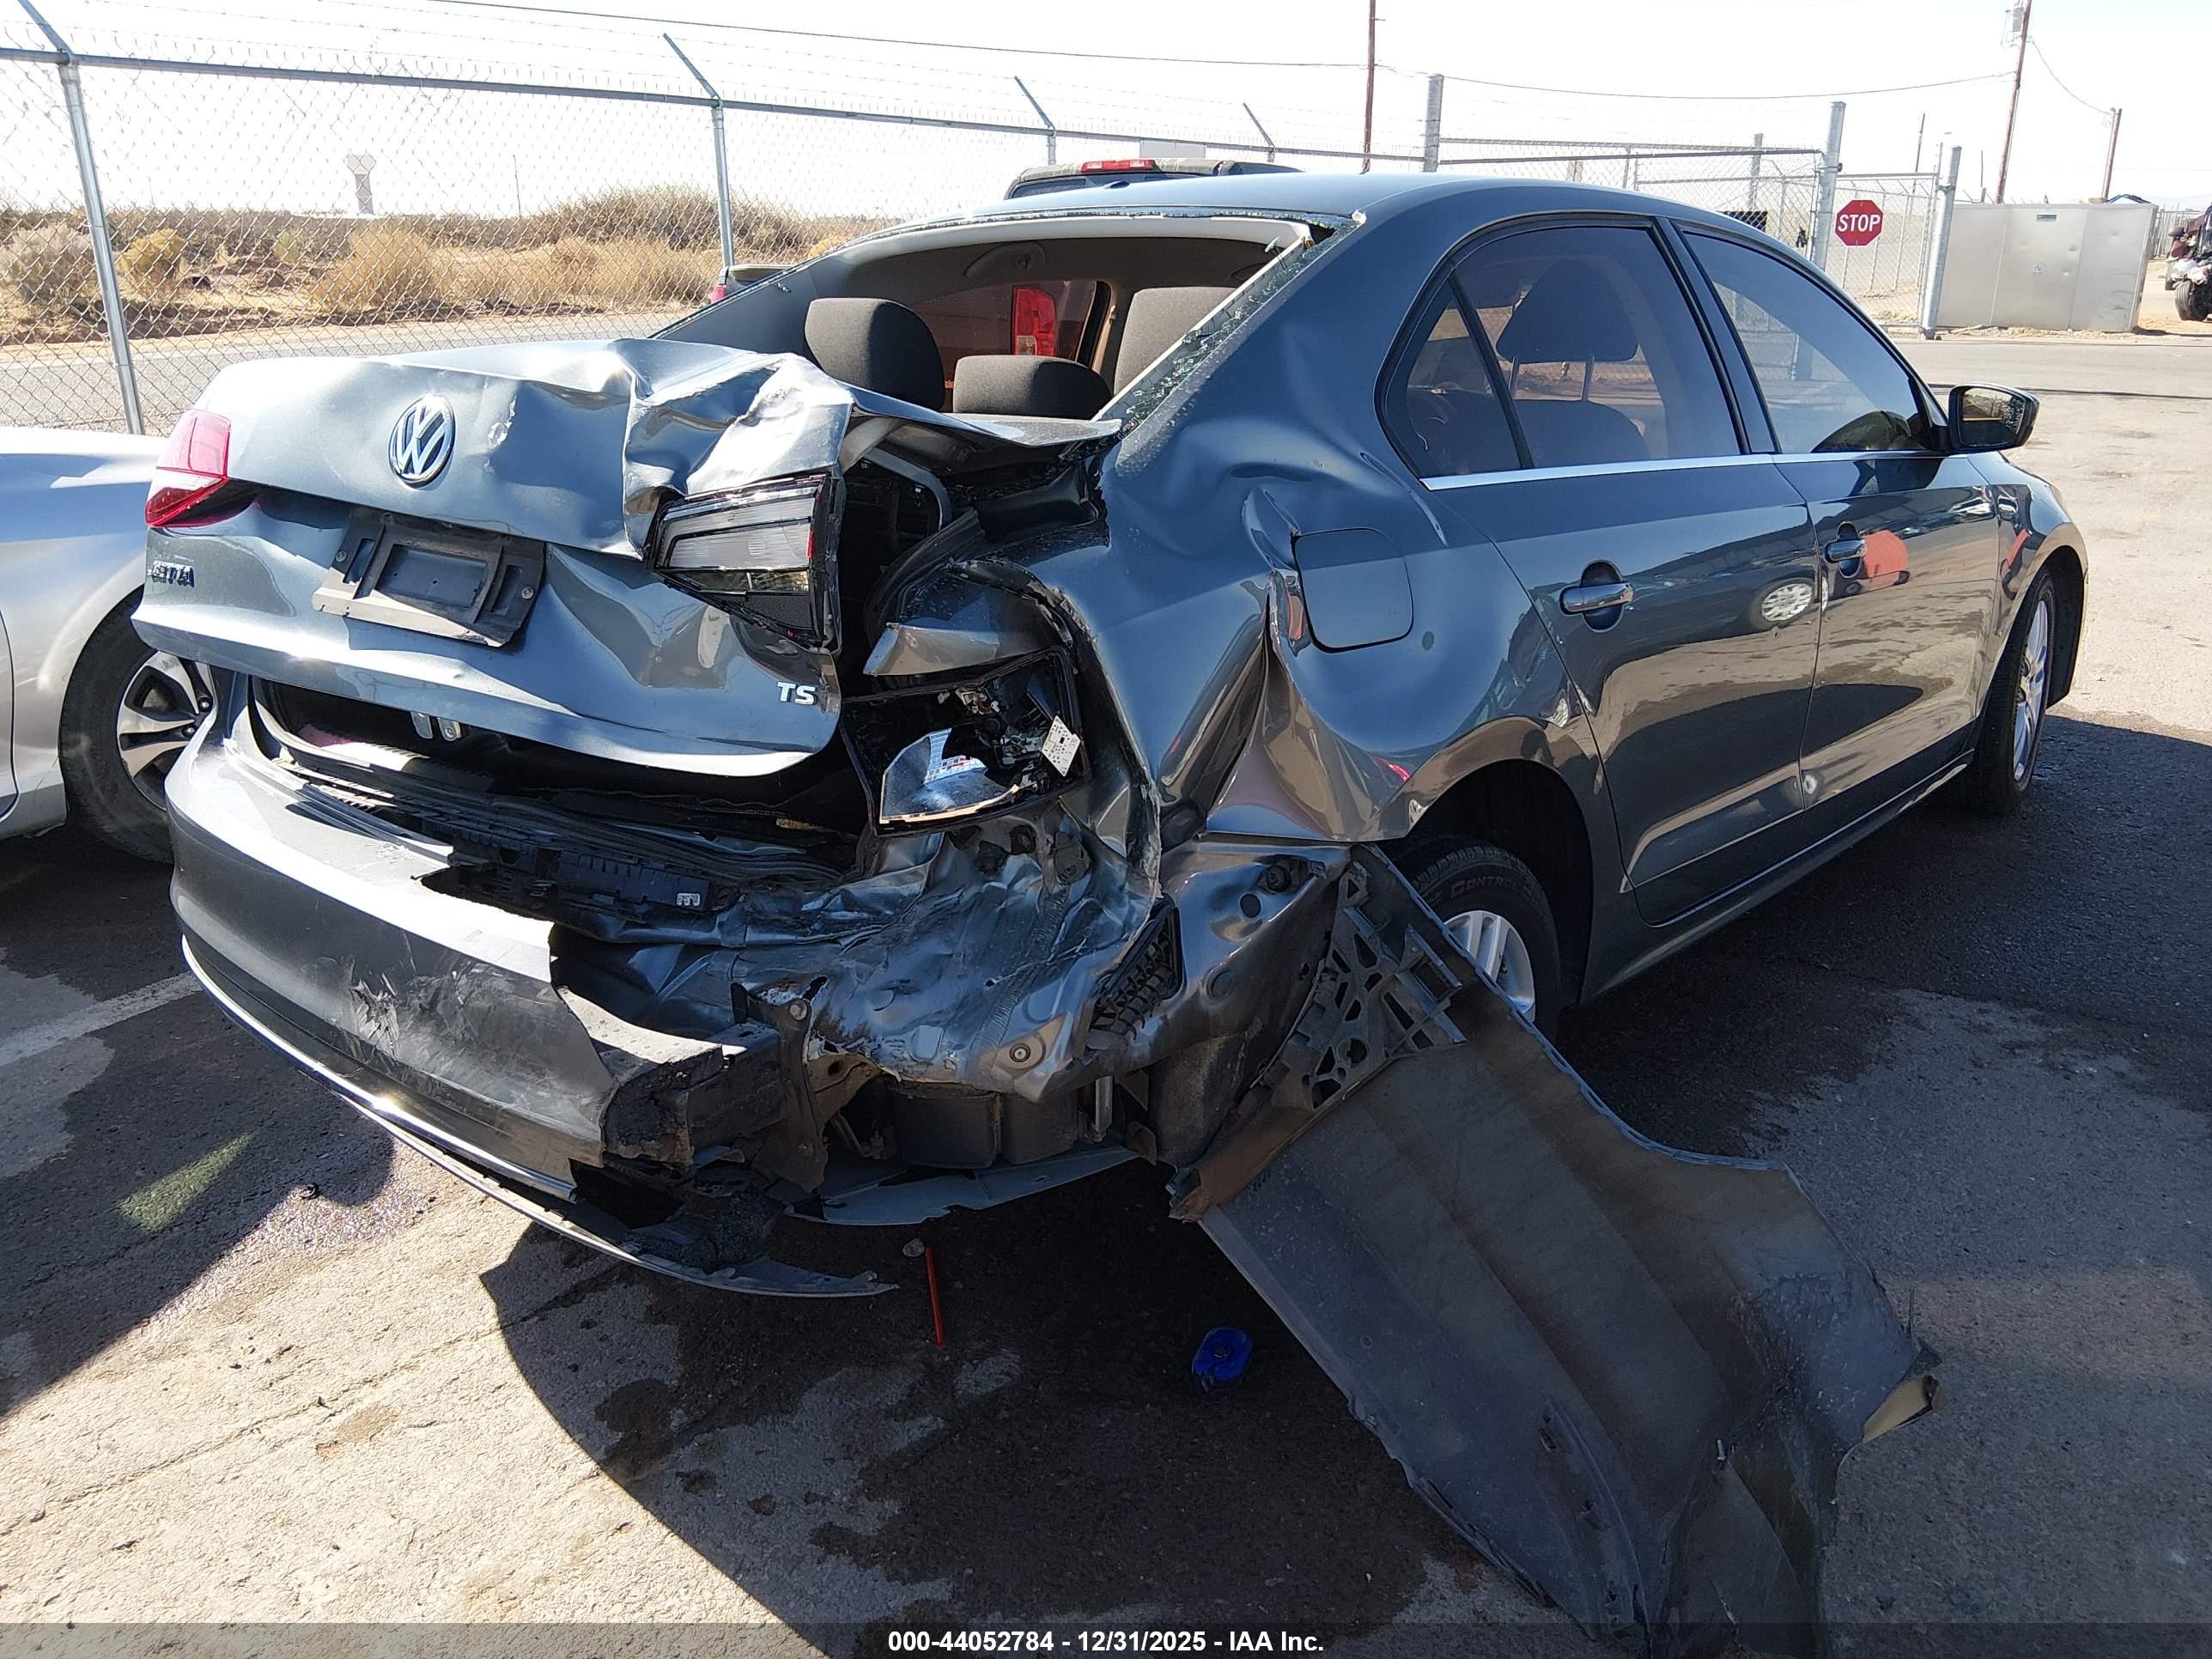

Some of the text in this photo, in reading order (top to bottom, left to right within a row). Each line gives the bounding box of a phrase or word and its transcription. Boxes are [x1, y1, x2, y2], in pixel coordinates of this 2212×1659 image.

[1838, 214, 1881, 232] STOP
[392, 395, 453, 483] VW
[777, 682, 817, 704] TS
